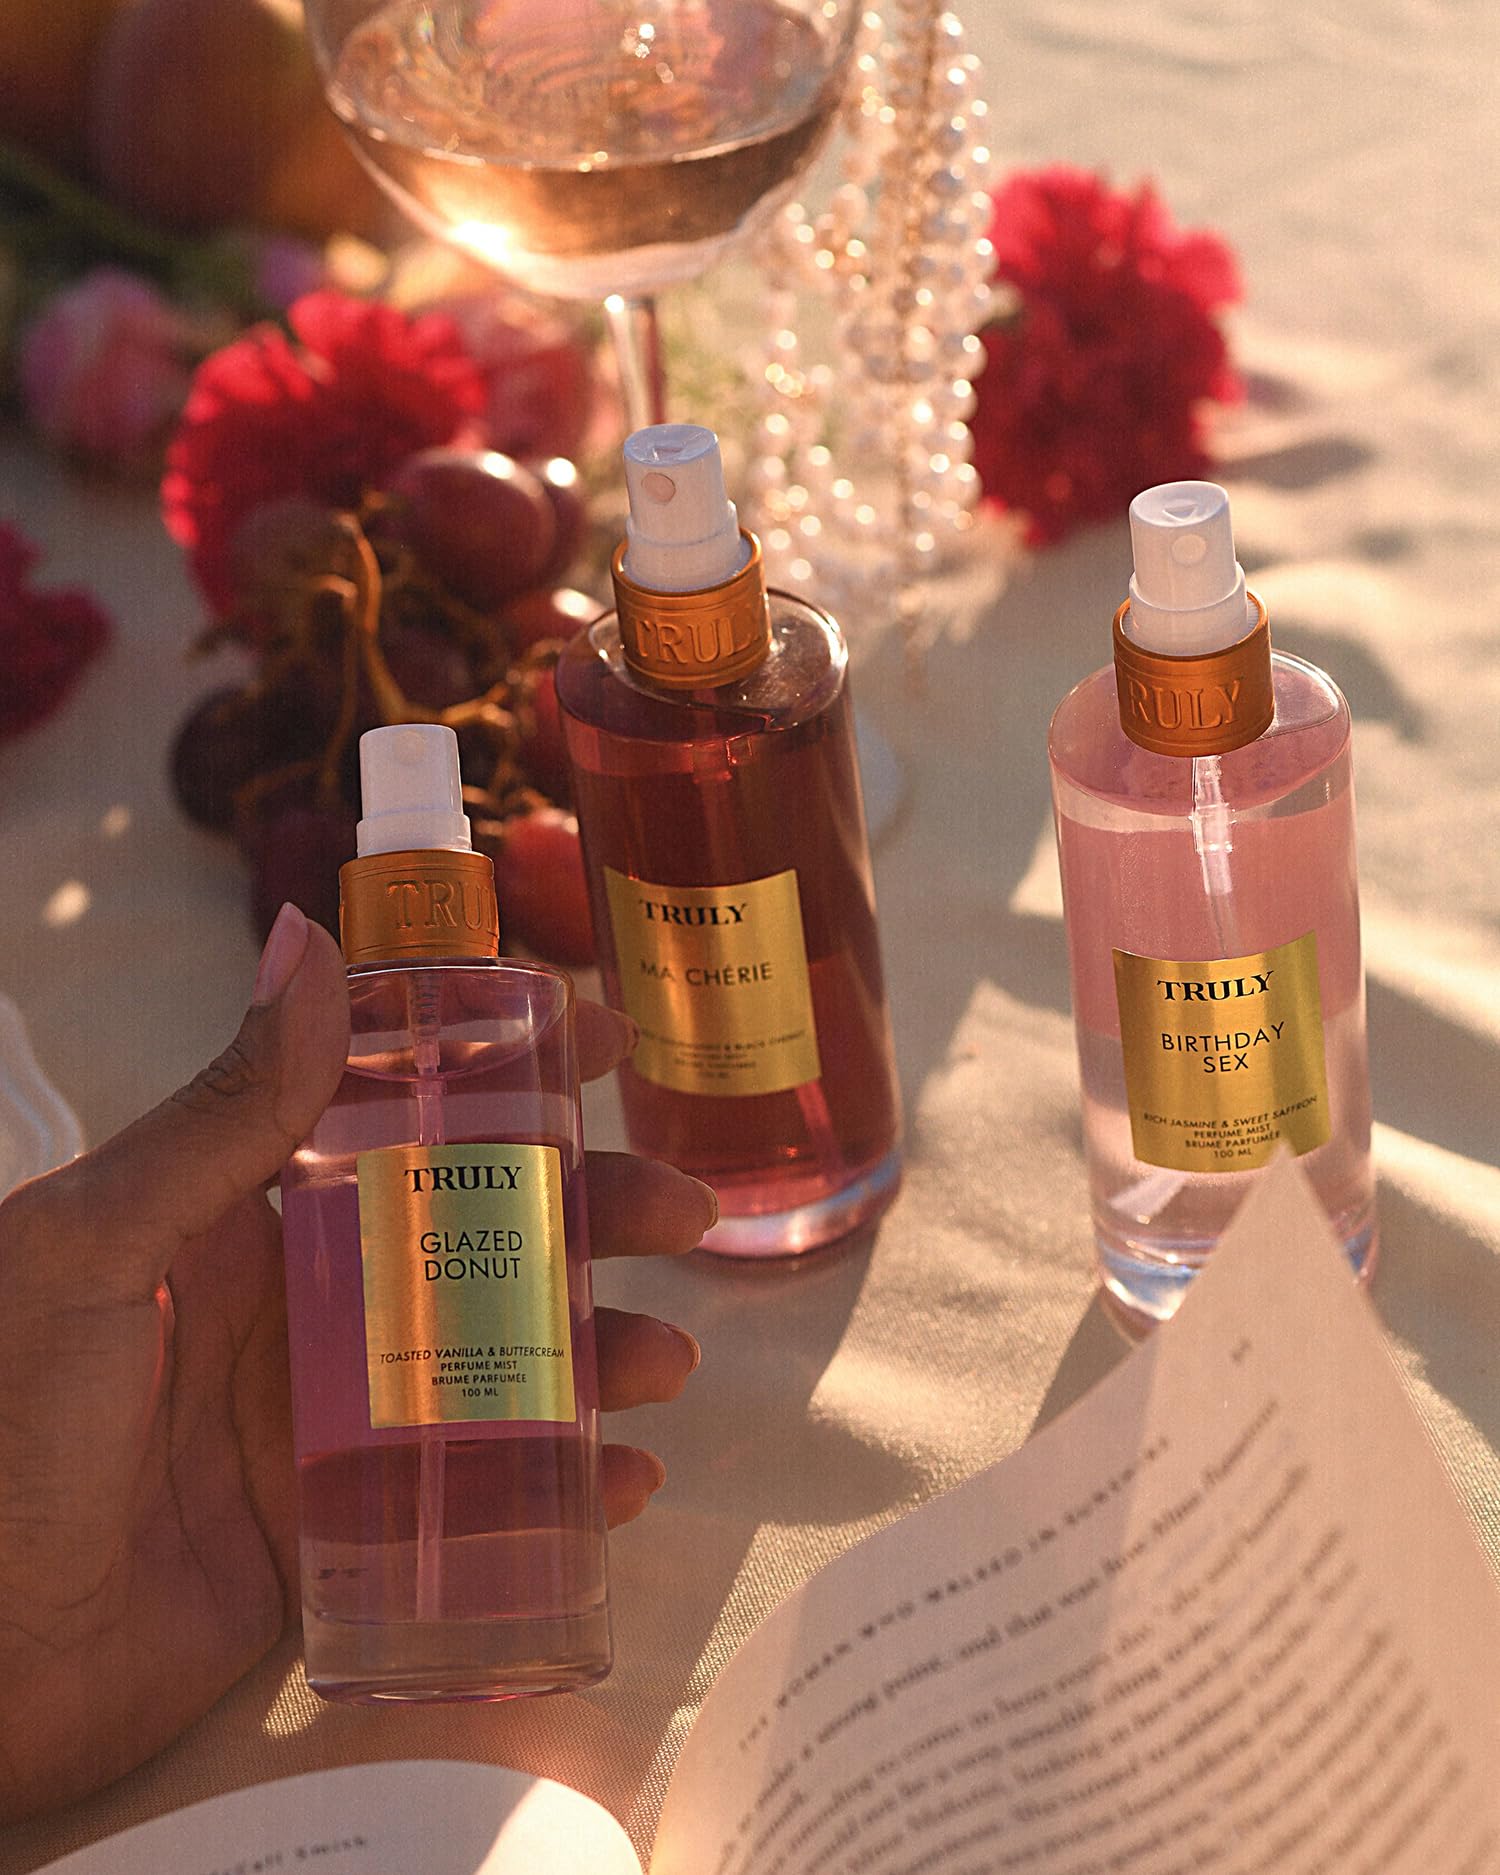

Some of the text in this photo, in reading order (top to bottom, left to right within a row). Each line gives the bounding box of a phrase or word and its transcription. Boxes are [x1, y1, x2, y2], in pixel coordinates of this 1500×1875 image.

[640, 898, 747, 926] TRULY
[640, 958, 774, 986] MA CHÉRIE
[1156, 970, 1274, 1001] TRULY
[1161, 1021, 1285, 1052] BIRTHDAY
[1203, 1053, 1249, 1073] SEX
[1143, 1095, 1318, 1129] RICH JASMINE & SWEET SAFFRON
[1194, 1124, 1271, 1139] PERFUME MIST
[1185, 1139, 1221, 1149] BRUME
[1213, 1148, 1252, 1159] 100 ML
[404, 1166, 522, 1193] TRULY
[420, 1230, 523, 1254] GLAZED
[425, 1257, 521, 1281] DONUT
[380, 1346, 565, 1364] TOASTED VANILLA & BUTTERCREAM
[440, 1360, 518, 1372] PERFUME MIST
[431, 1371, 527, 1386] BRUME PARFUMÉE
[462, 1387, 499, 1398] 100 ML
